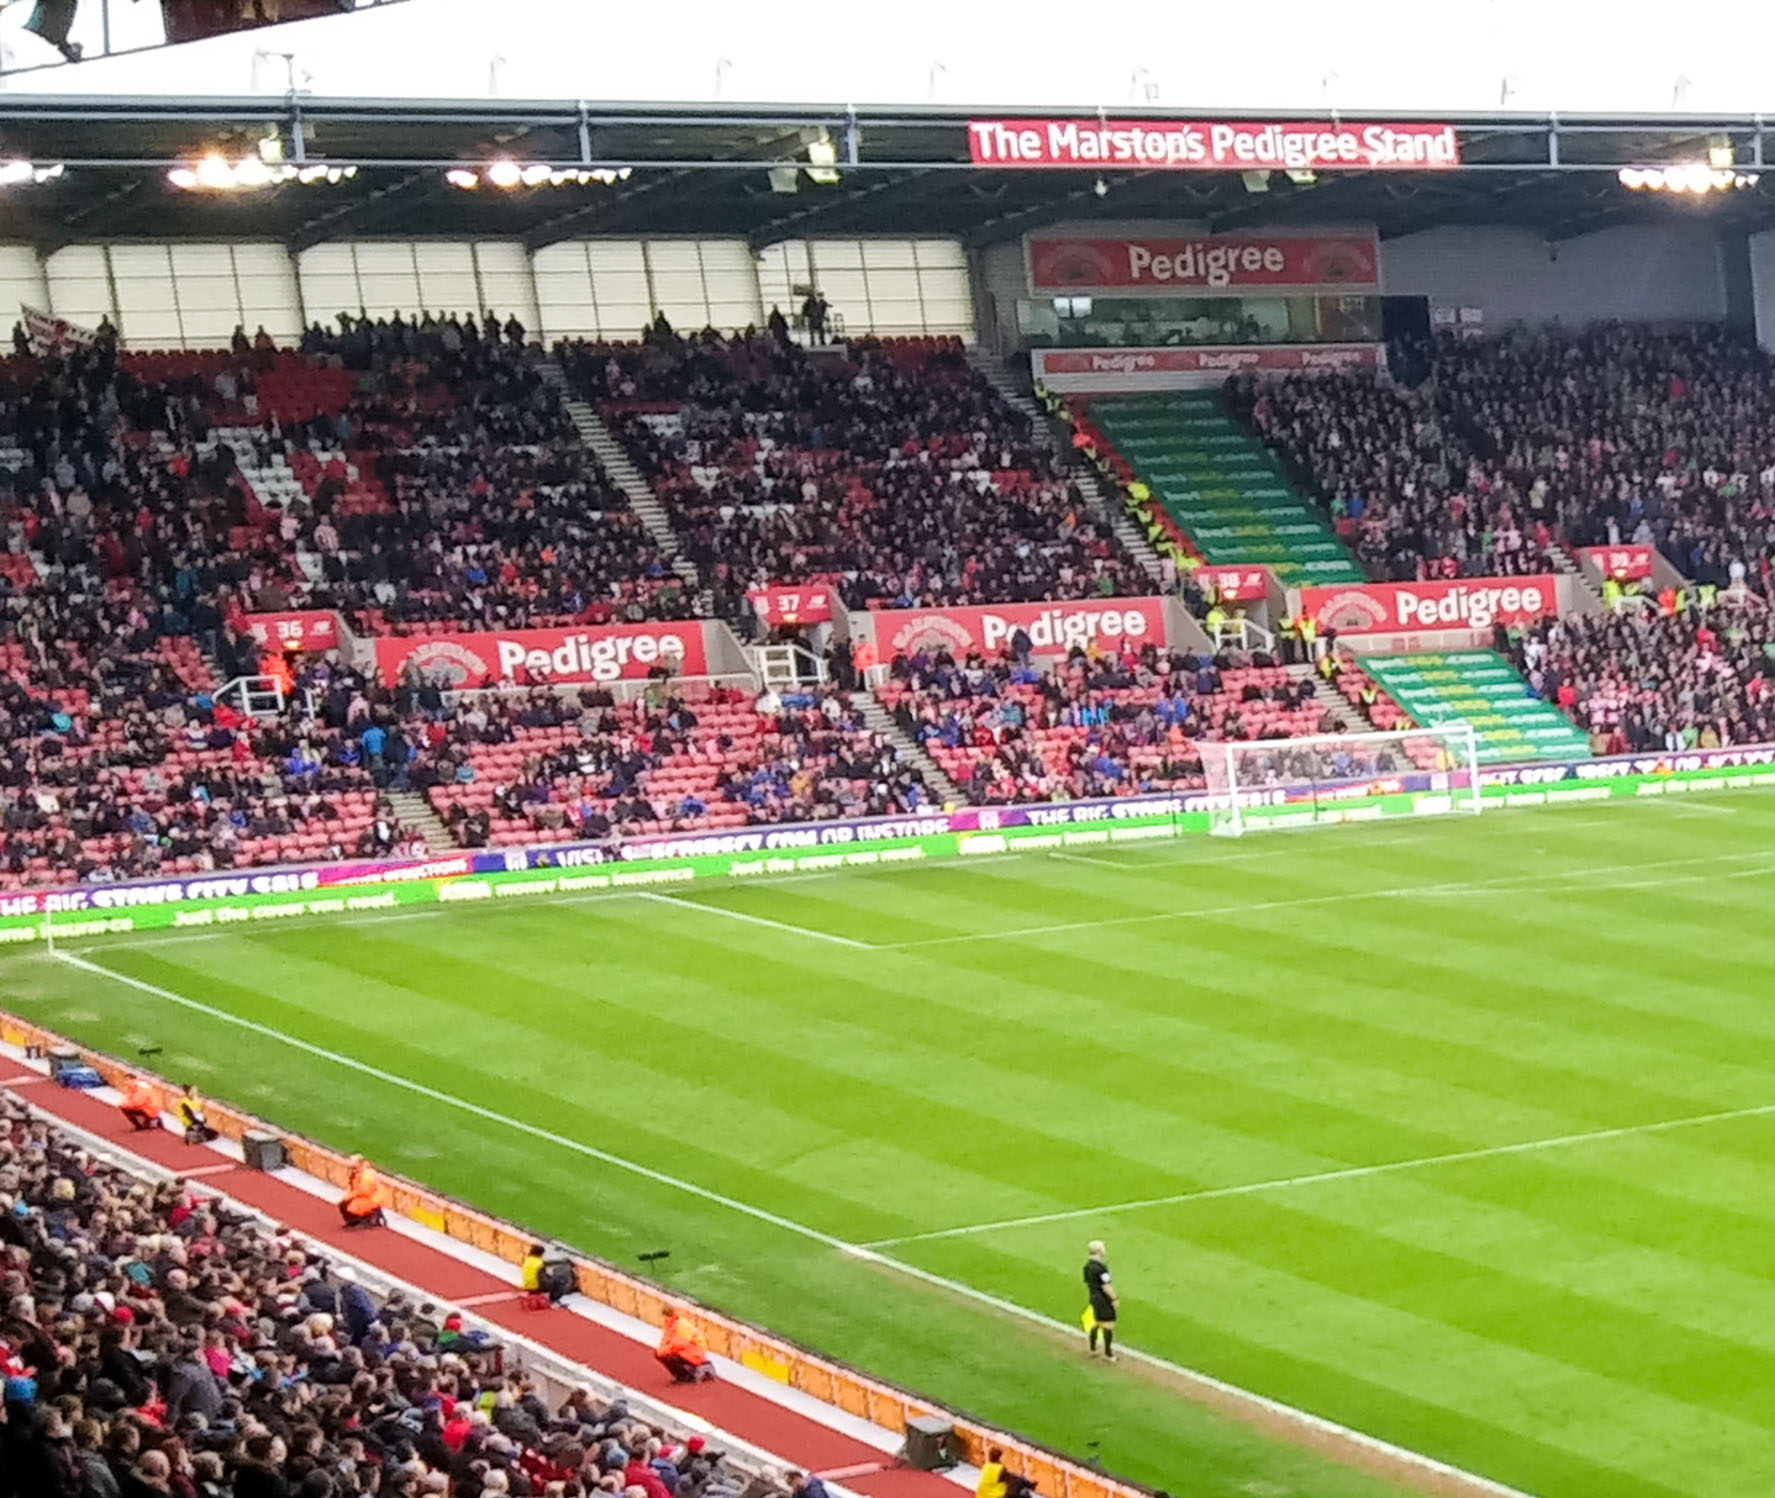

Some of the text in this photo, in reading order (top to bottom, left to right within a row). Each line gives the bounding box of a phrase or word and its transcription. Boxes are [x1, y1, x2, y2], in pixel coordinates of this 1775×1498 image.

[970, 122, 1456, 168] The Marston's Pedigree Stand
[1128, 244, 1284, 287] Pedigree
[779, 597, 800, 612] 37
[1397, 586, 1543, 629] Pedigree
[277, 620, 303, 638] 36
[983, 608, 1147, 652] Pdigree
[497, 634, 685, 681] Pedigree
[0, 896, 37, 915] HE
[45, 892, 88, 912] BIG
[91, 885, 183, 907] STOKE
[185, 878, 249, 899] CITY
[250, 871, 319, 893] SALE
